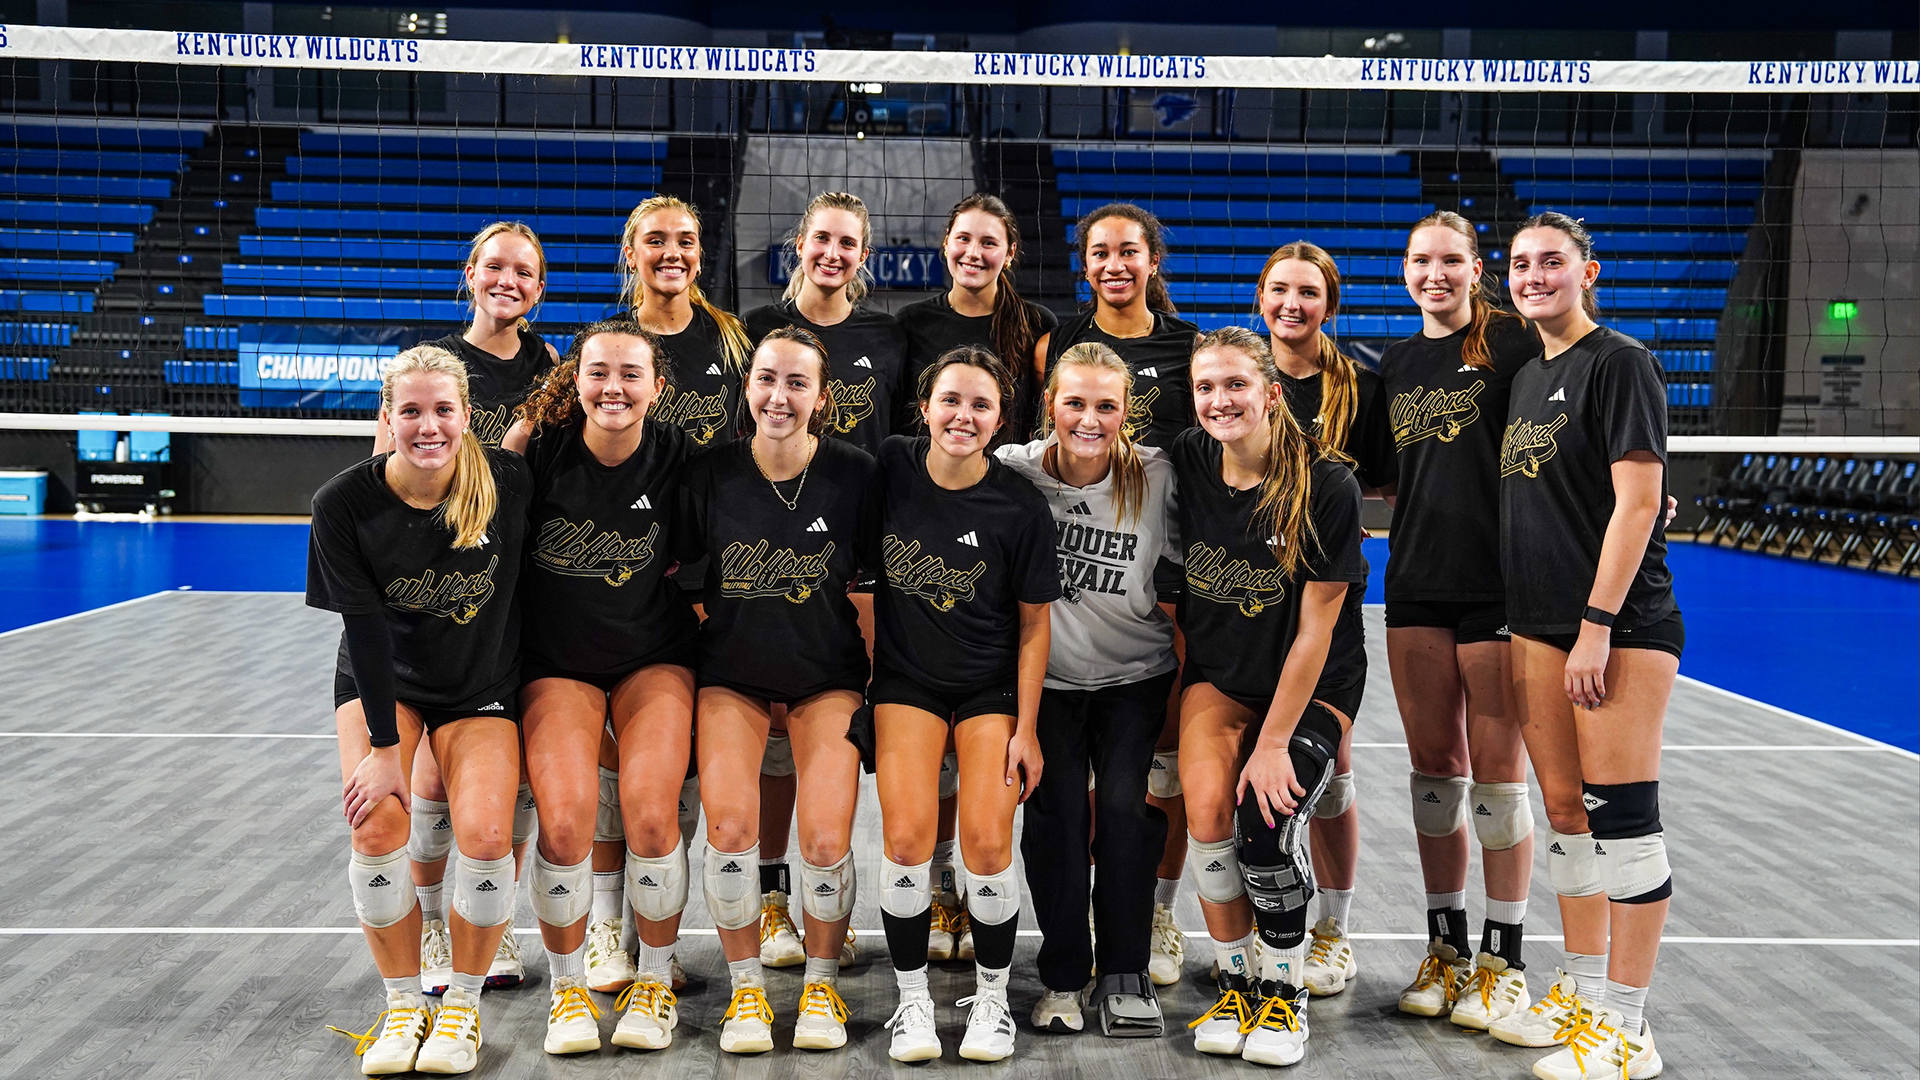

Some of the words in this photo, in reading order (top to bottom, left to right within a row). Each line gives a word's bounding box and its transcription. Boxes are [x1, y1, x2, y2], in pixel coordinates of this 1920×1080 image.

[176, 32, 298, 59] KENTUCKY
[305, 36, 419, 63] WILDCATS
[580, 45, 699, 70] KENTUCKY
[705, 48, 816, 72] WILDCATS
[974, 53, 1090, 77] KENTUCKY
[1097, 55, 1206, 79] WILDCATS
[1361, 59, 1475, 82] KENTUCKY
[1482, 60, 1591, 84] WILDCATS
[1748, 62, 1866, 84] KENTUCKY
[1873, 61, 1920, 84] WIL
[782, 251, 935, 282] KCKY
[90, 474, 145, 485] POWERADE
[536, 517, 660, 569] Wofford
[1054, 521, 1138, 561] NQUER
[721, 538, 836, 589] Wofford
[882, 533, 987, 590] Wofford
[1057, 557, 1127, 596] VAIL
[1185, 541, 1290, 596] Wofford
[385, 554, 499, 608] Wofford
